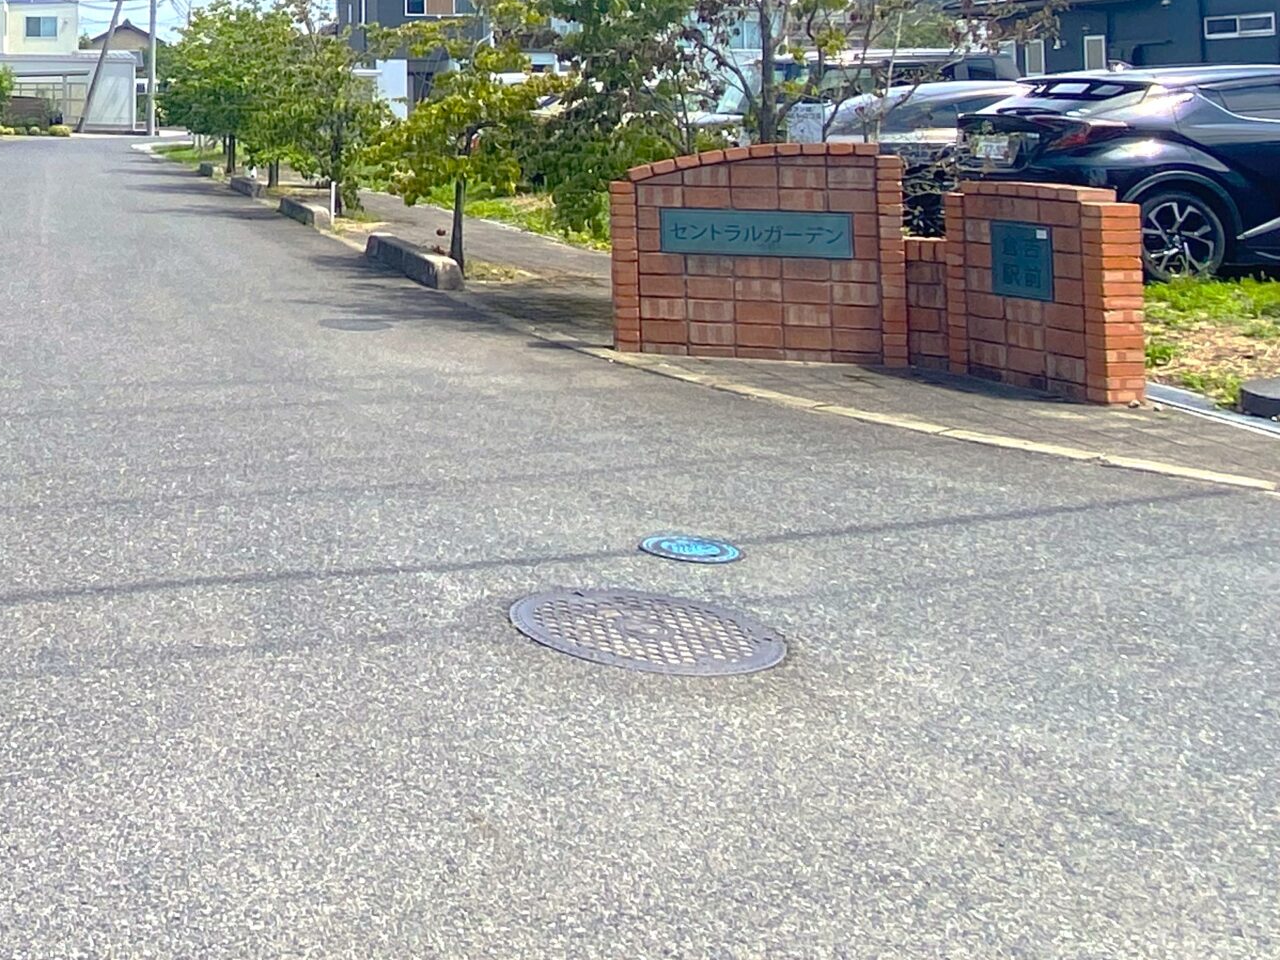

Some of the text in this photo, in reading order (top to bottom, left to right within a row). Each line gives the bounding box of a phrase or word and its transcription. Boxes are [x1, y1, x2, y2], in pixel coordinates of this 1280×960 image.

[670, 222, 844, 245] セントラルガーデン
